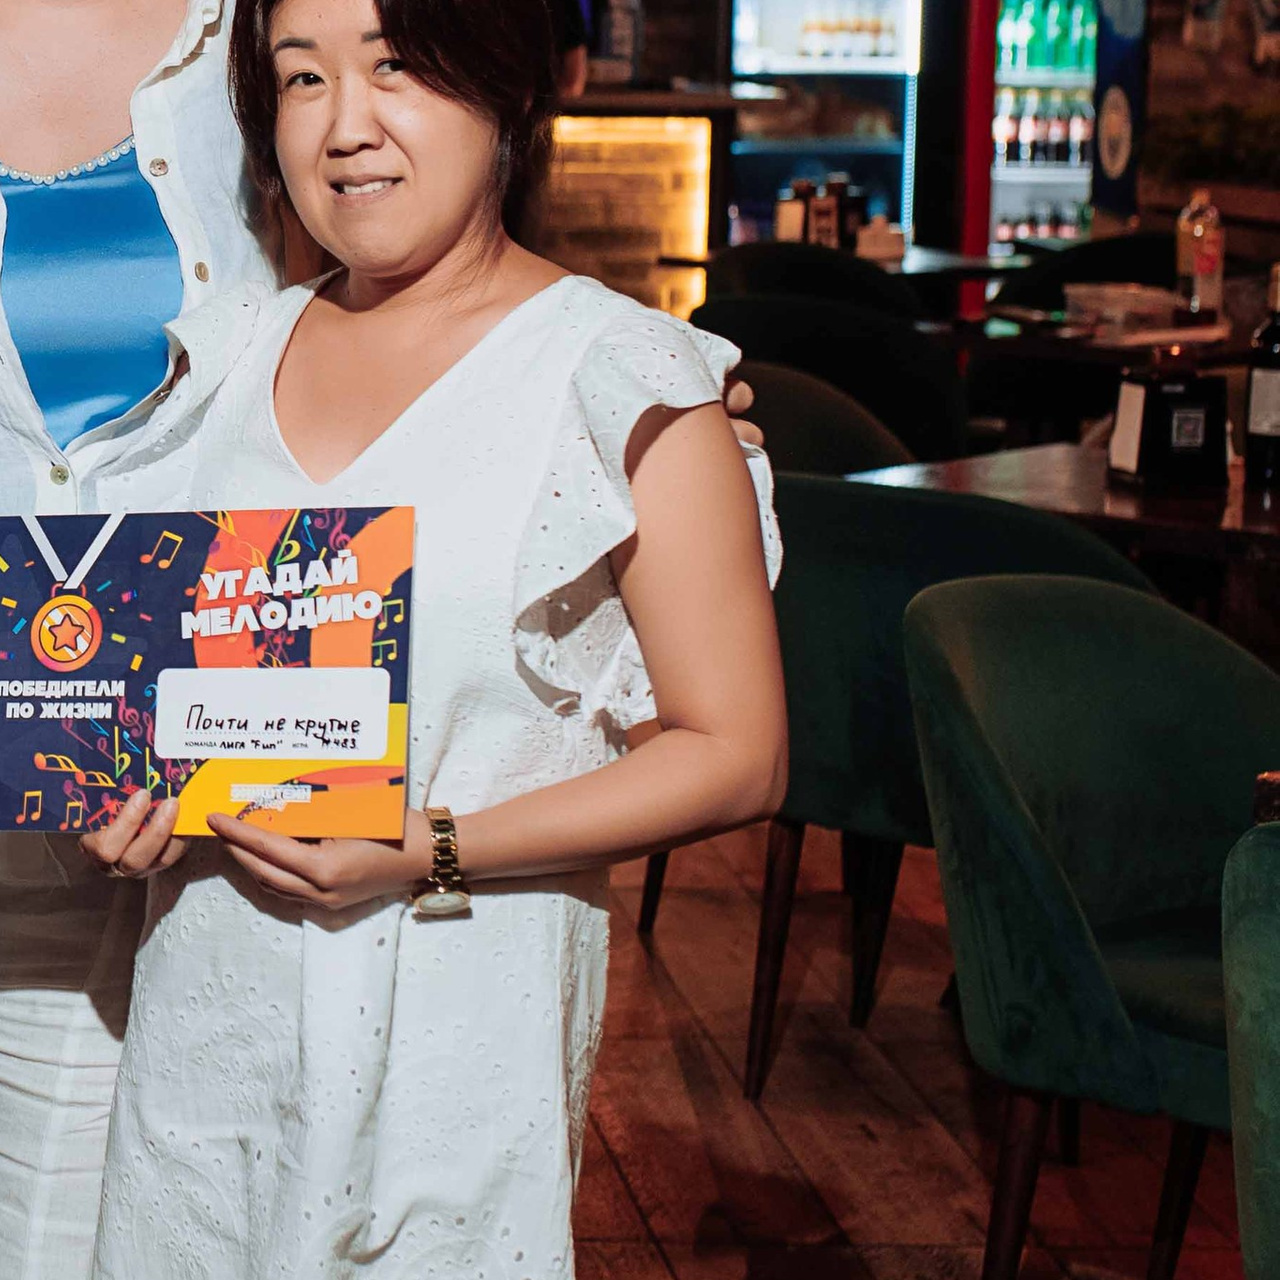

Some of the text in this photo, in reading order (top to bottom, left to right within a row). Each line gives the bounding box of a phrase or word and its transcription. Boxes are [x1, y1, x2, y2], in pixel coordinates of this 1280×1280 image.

[200, 549, 358, 601] УГАДАЙ
[181, 590, 383, 639] МЕЛОДИЮ
[6, 702, 112, 719] ПО ЖИЗНИ
[185, 704, 249, 731] Почти
[264, 717, 286, 732] не
